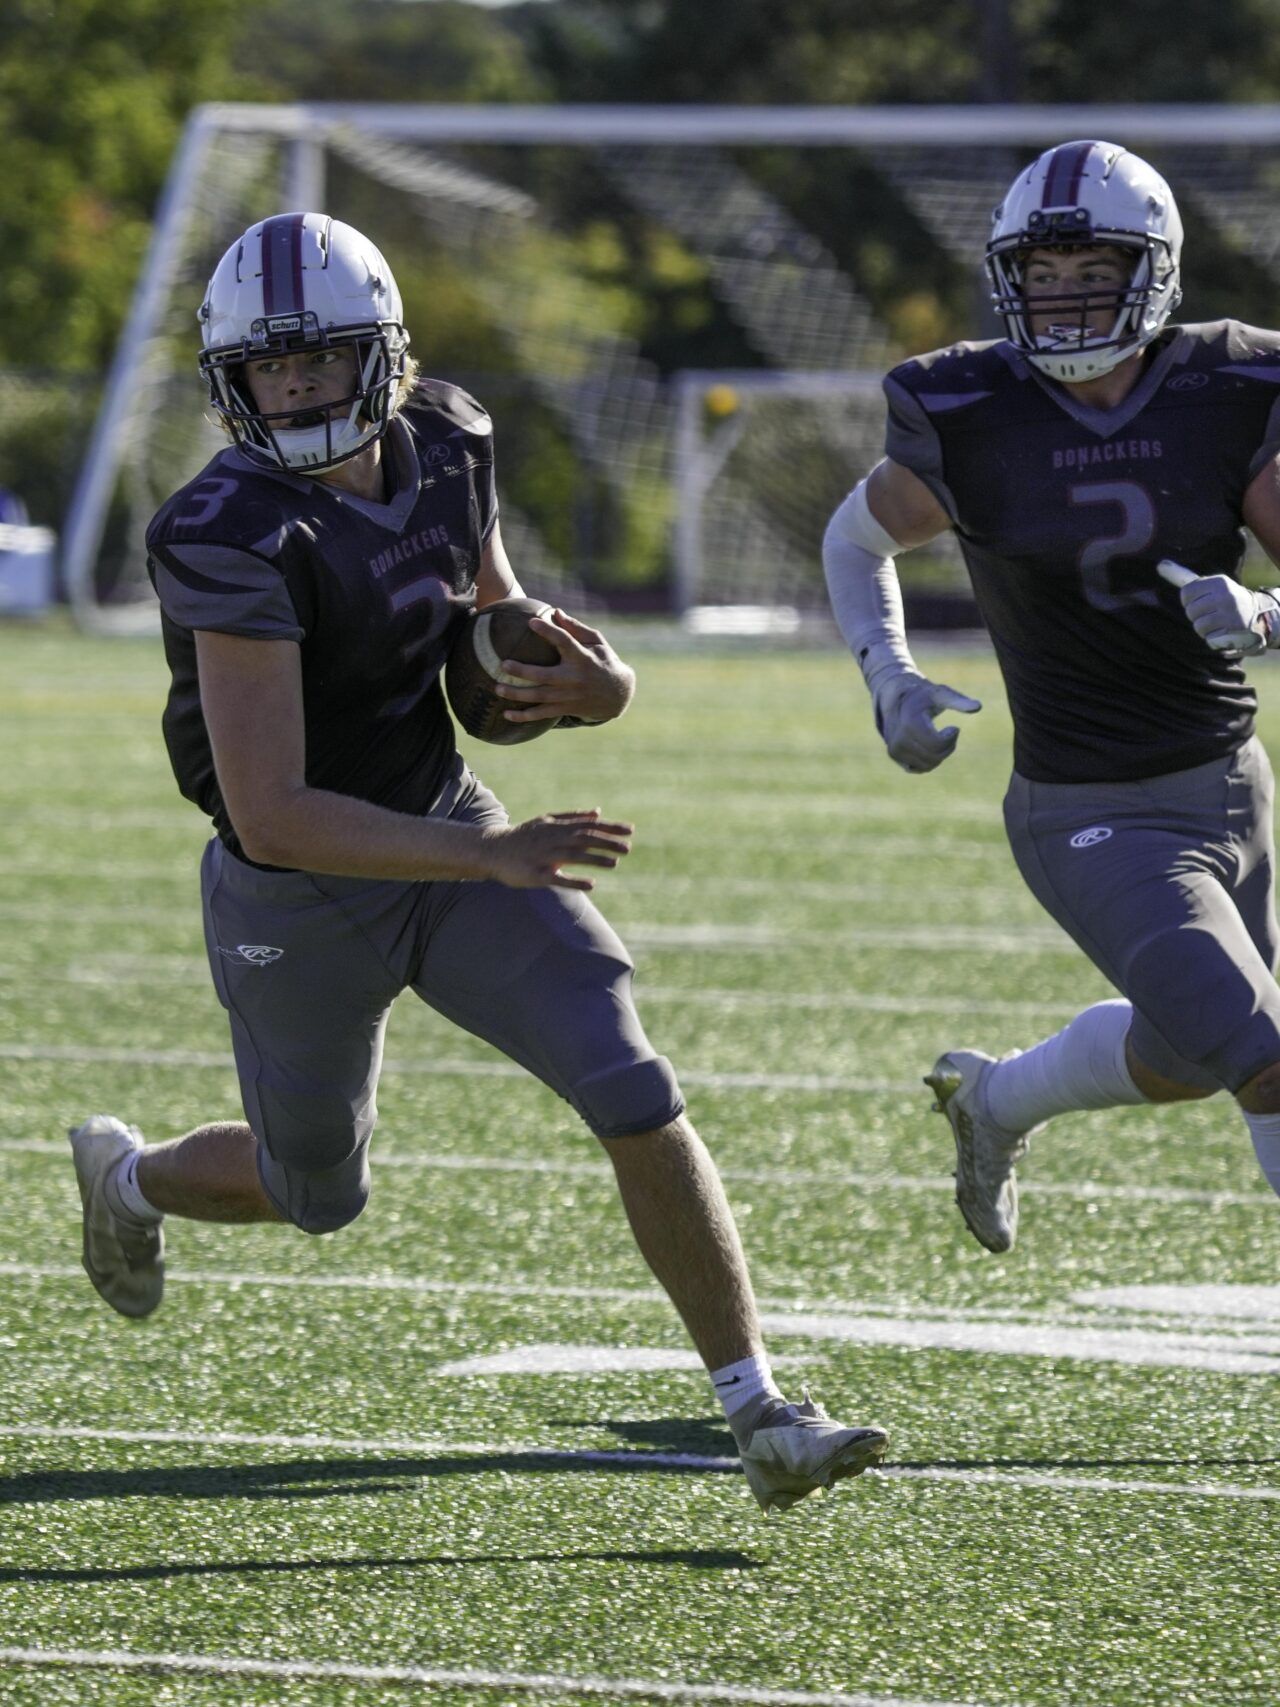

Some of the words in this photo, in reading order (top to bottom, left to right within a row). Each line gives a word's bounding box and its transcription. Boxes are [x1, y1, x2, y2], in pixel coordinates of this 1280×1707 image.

[271, 320, 299, 331] schutt
[1053, 440, 1163, 470] BONACKERS
[174, 477, 239, 526] 3
[369, 524, 449, 579] BONACKERS
[1068, 481, 1159, 611] 2
